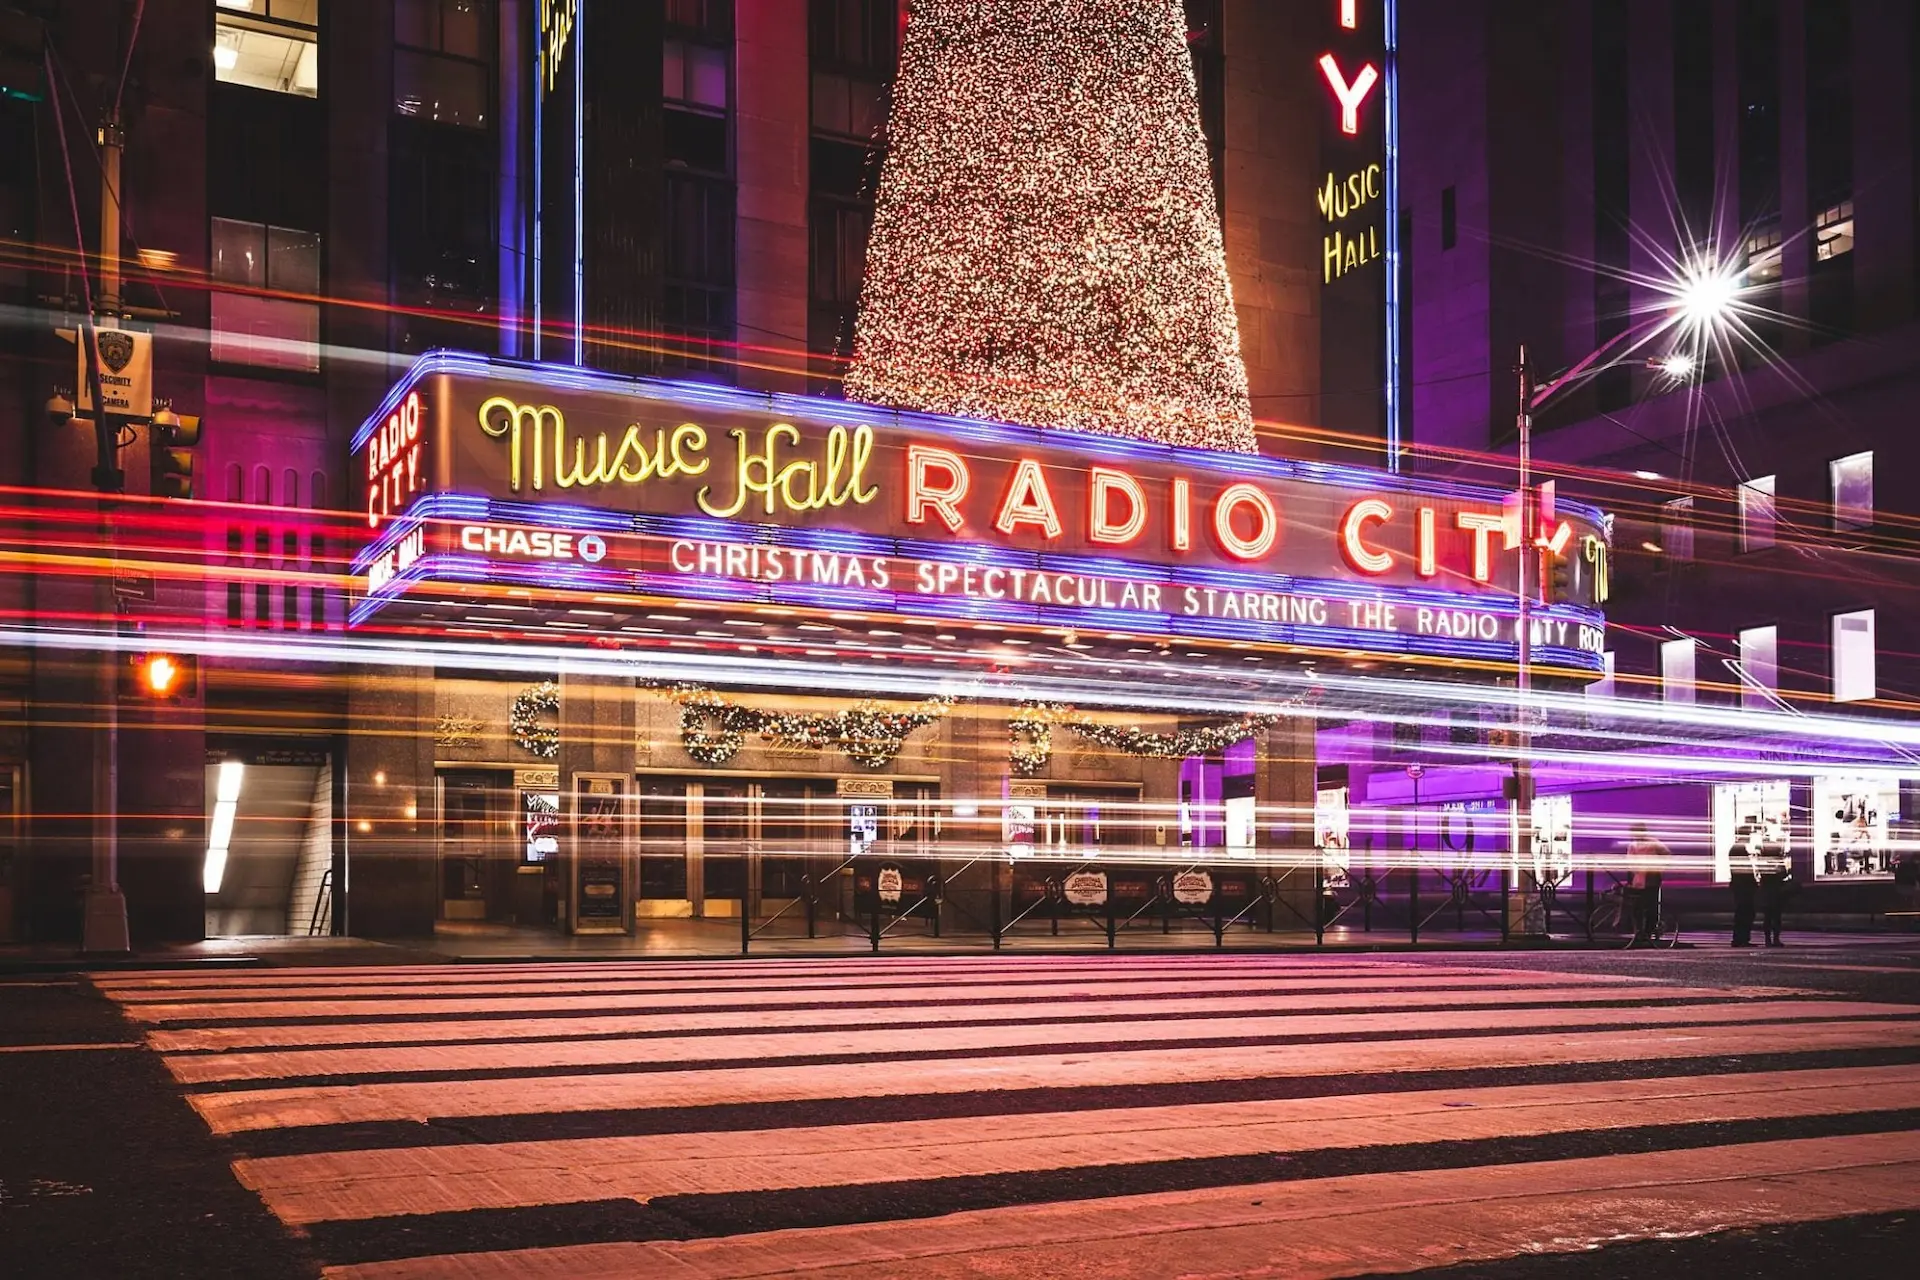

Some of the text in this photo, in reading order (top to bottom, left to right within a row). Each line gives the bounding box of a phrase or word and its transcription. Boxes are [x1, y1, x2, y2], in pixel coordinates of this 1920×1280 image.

[1318, 164, 1380, 222] MUSIC
[1324, 226, 1381, 284] HALL
[100, 374, 131, 387] SECURITY
[102, 396, 129, 408] CAMERA
[368, 391, 419, 480] RADIO
[478, 396, 880, 518] Music Hall
[368, 444, 420, 528] CITY
[907, 444, 1279, 560] RADIO
[461, 526, 574, 559] CHASE
[671, 540, 891, 590] CHRISTMAS
[917, 563, 1162, 612] SPECTACULAR
[1183, 588, 1328, 625] STARRING
[1348, 600, 1398, 632] THE
[1417, 609, 1499, 639] RADIO
